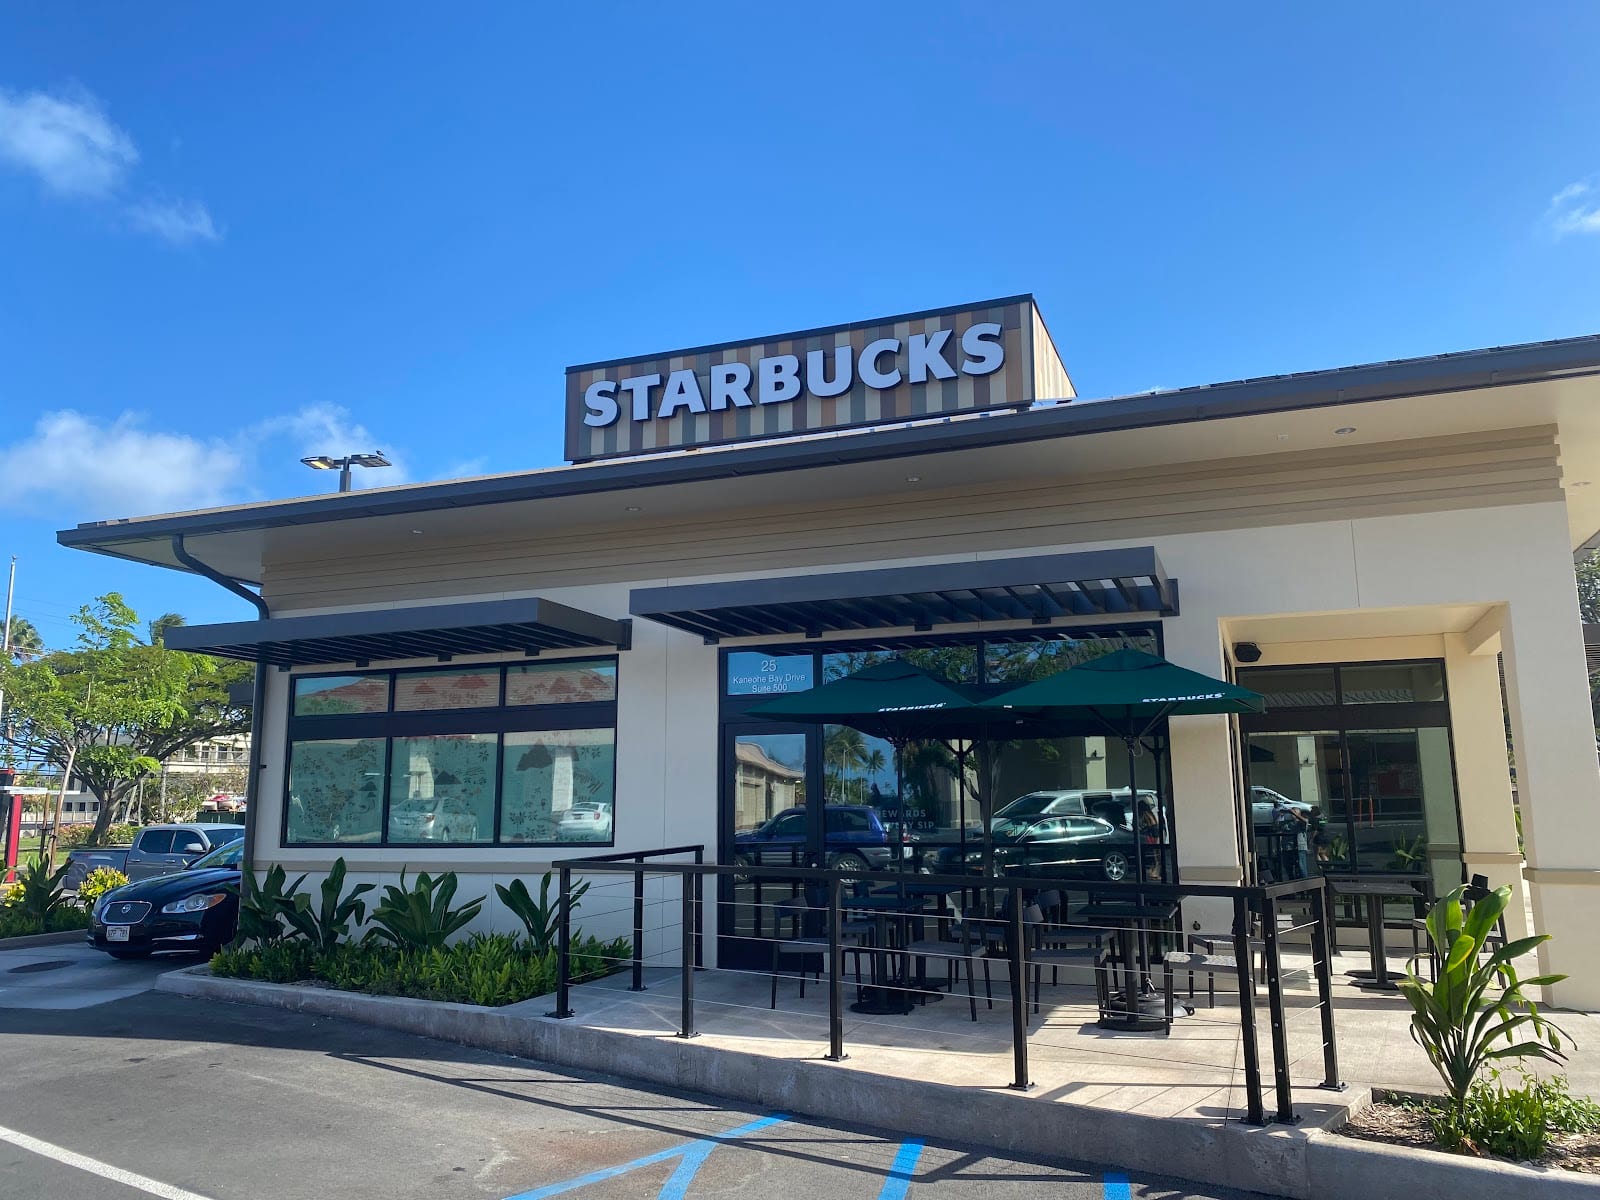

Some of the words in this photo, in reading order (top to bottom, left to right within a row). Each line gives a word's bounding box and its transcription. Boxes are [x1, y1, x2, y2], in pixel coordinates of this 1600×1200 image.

[583, 323, 1005, 427] STARBUCKS
[761, 659, 777, 672] 25
[733, 676, 766, 684] Kaneohe
[769, 675, 783, 683] Bay
[786, 673, 806, 681] Drive
[752, 684, 771, 692] Suite
[773, 683, 788, 691] 500
[1142, 693, 1226, 703] STARBUCKS
[878, 702, 946, 712] STARBUCKS
[917, 821, 934, 829] SIP
